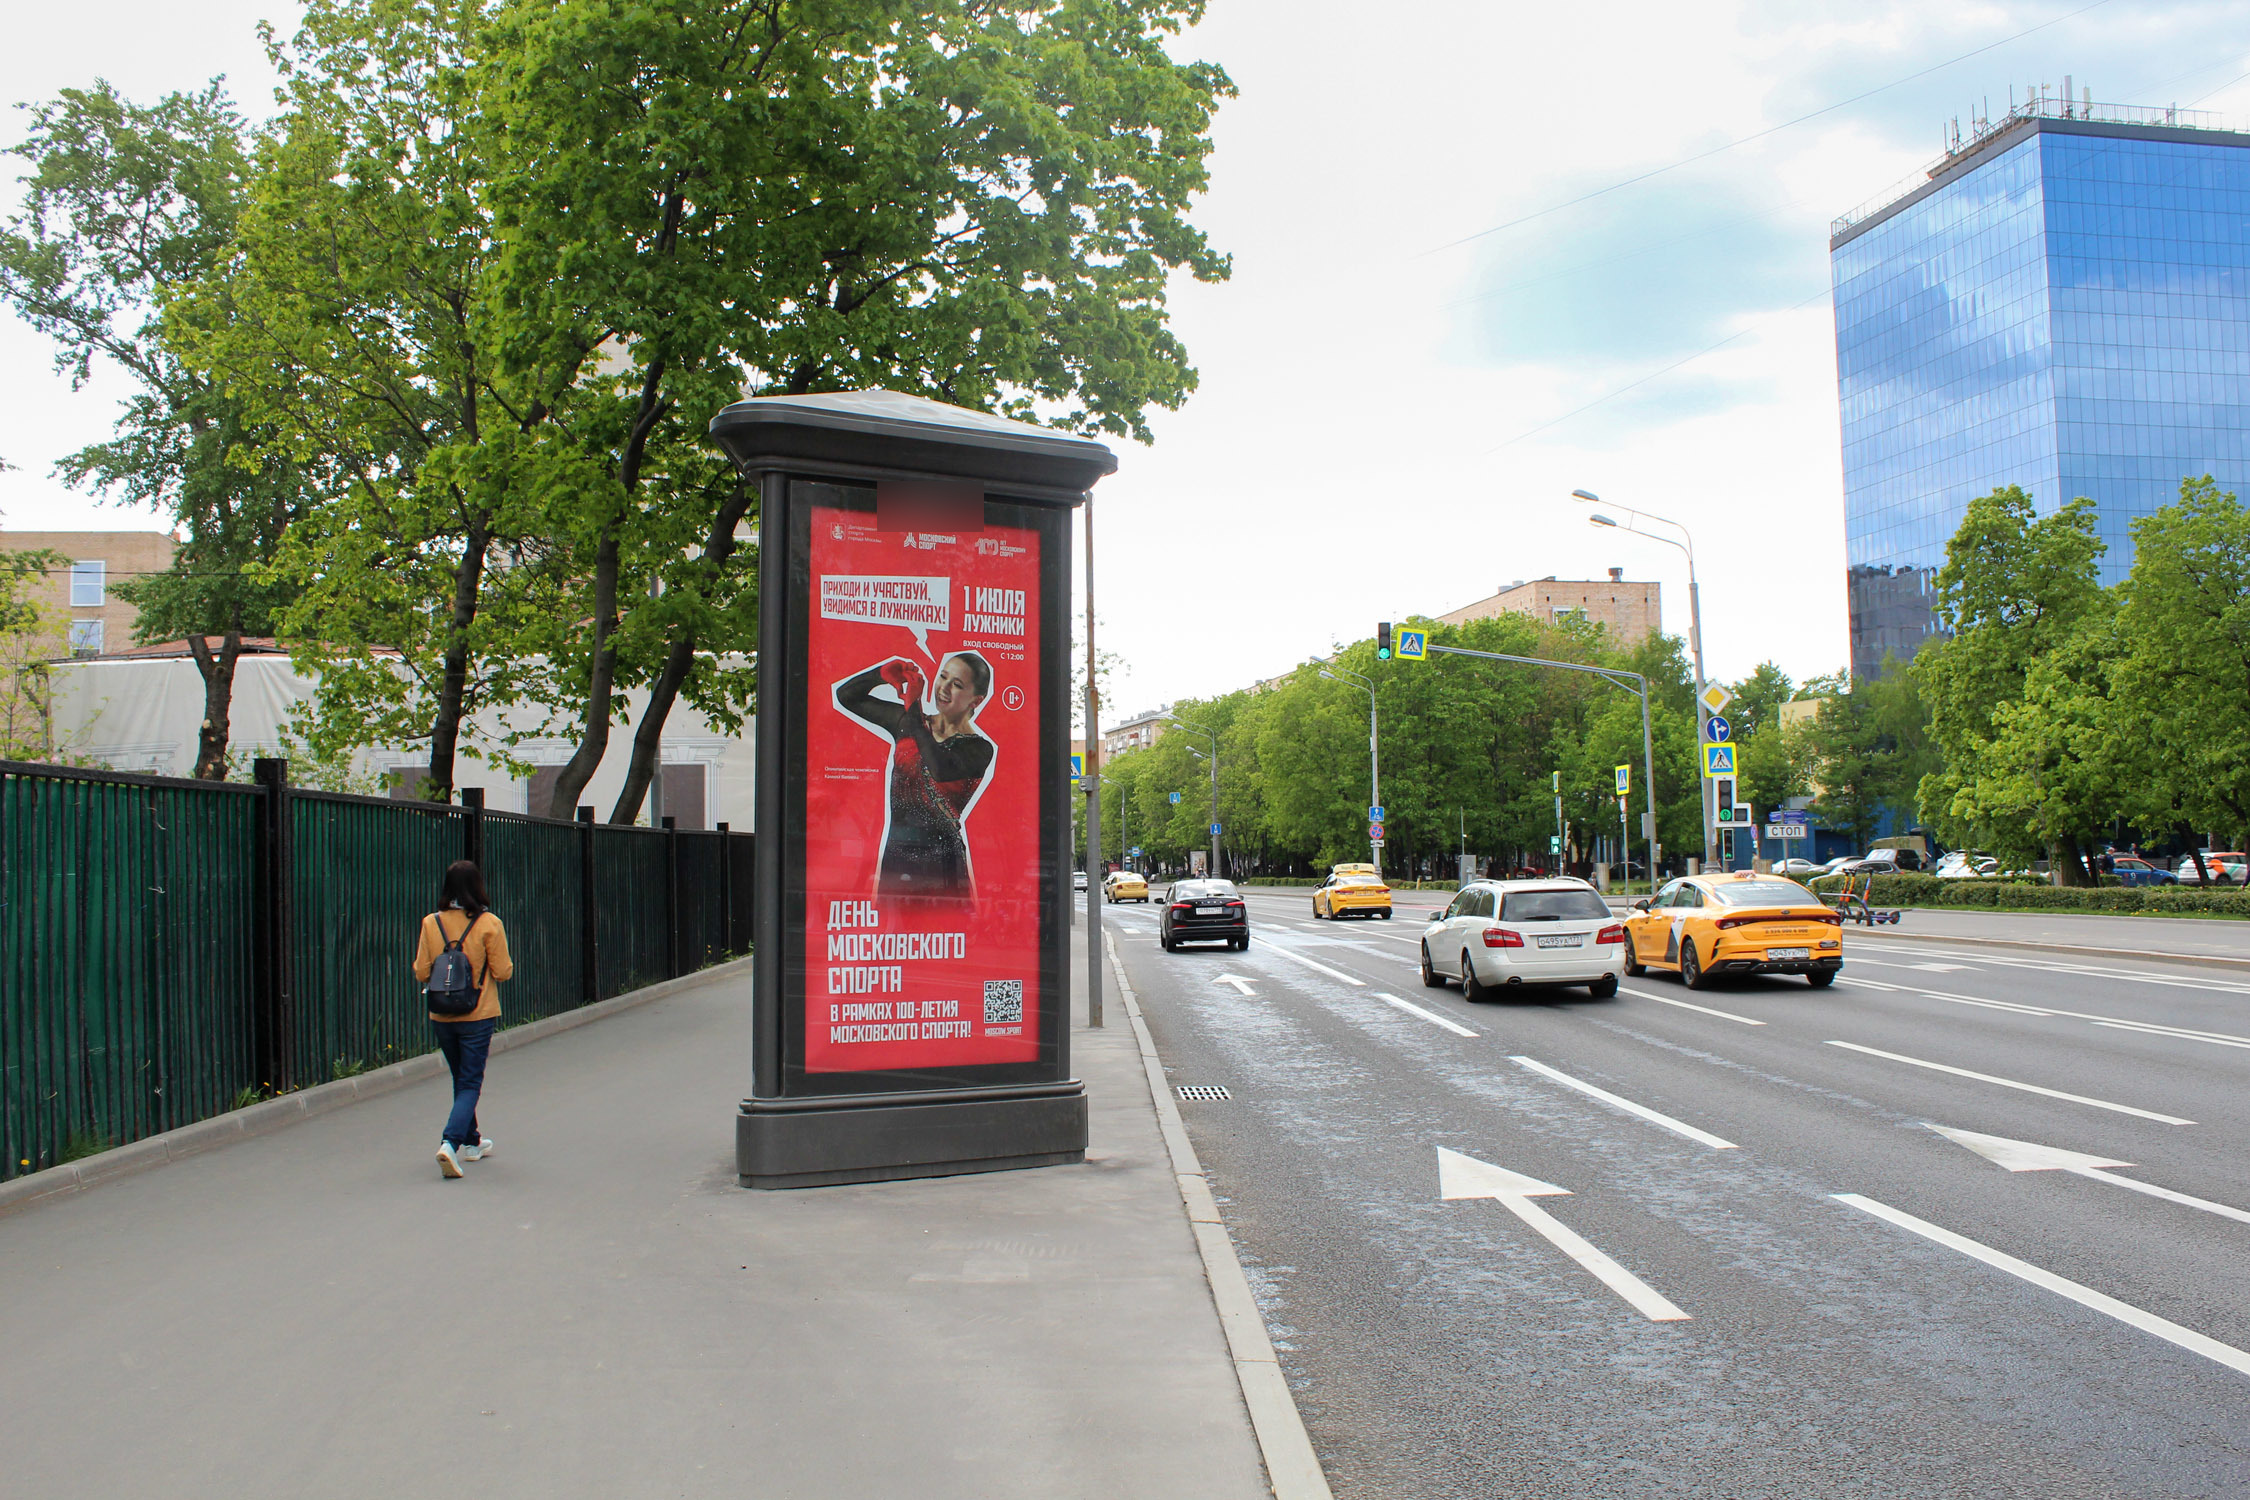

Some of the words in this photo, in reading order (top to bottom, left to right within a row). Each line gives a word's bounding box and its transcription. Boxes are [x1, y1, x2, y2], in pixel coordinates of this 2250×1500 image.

[919, 533, 956, 545] МОСКОВСКИЙ
[919, 541, 937, 550] СПОРТ
[823, 581, 860, 598] ПРИХОДИ
[863, 581, 870, 597] И
[873, 580, 932, 603] УЧАСТВУЙ,
[963, 585, 970, 612] 1
[976, 586, 1026, 616] ИЮЛЯ
[823, 598, 868, 616] УВИДИМСЯ
[870, 601, 877, 617] В
[880, 602, 946, 625] ЛУЖНИКАХ!
[963, 613, 1025, 636] ЛУЖНИКИ
[963, 640, 982, 649] ВХОД
[982, 641, 1025, 651] СВОБОДНЫЙ
[1000, 652, 1006, 660] С
[1007, 653, 1025, 661] 12:00
[1009, 691, 1020, 705] 0+
[1771, 826, 1801, 836] СТОП
[827, 900, 879, 931] ДЕНЬ
[827, 932, 966, 961] МОСКОВСКОГО
[828, 965, 902, 994] СПОРТА
[830, 1004, 839, 1022] В
[842, 1002, 893, 1022] РАМКАХ
[896, 1000, 959, 1019] 100-ЛЕТИЯ
[830, 1022, 918, 1044] МОСКОВСКОГО
[921, 1020, 972, 1039] СПОРТА!
